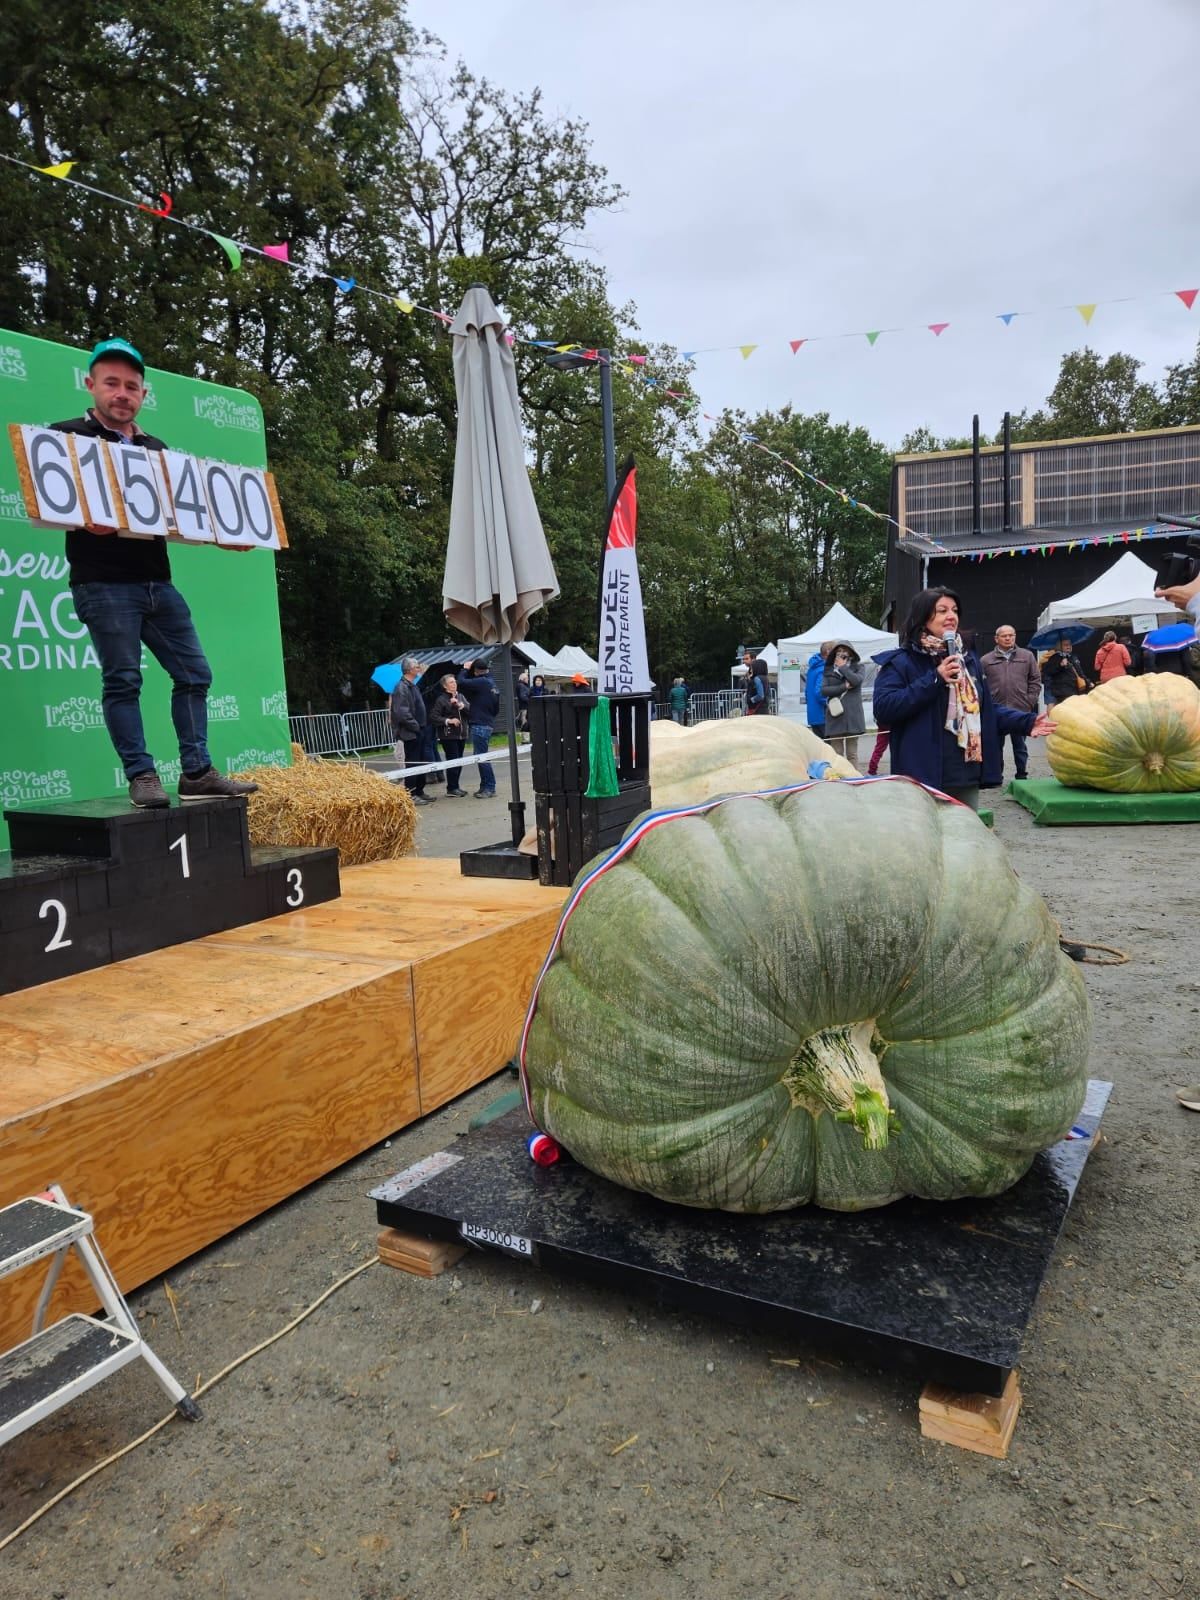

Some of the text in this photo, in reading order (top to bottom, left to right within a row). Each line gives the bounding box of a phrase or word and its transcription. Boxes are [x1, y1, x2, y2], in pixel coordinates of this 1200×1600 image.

[31, 433, 273, 541] 615.400
[603, 568, 618, 693] ENDÉE
[618, 568, 633, 694] DÉPARTEMENT
[169, 833, 190, 879] 1
[286, 868, 304, 907] 3
[38, 899, 73, 953] 2
